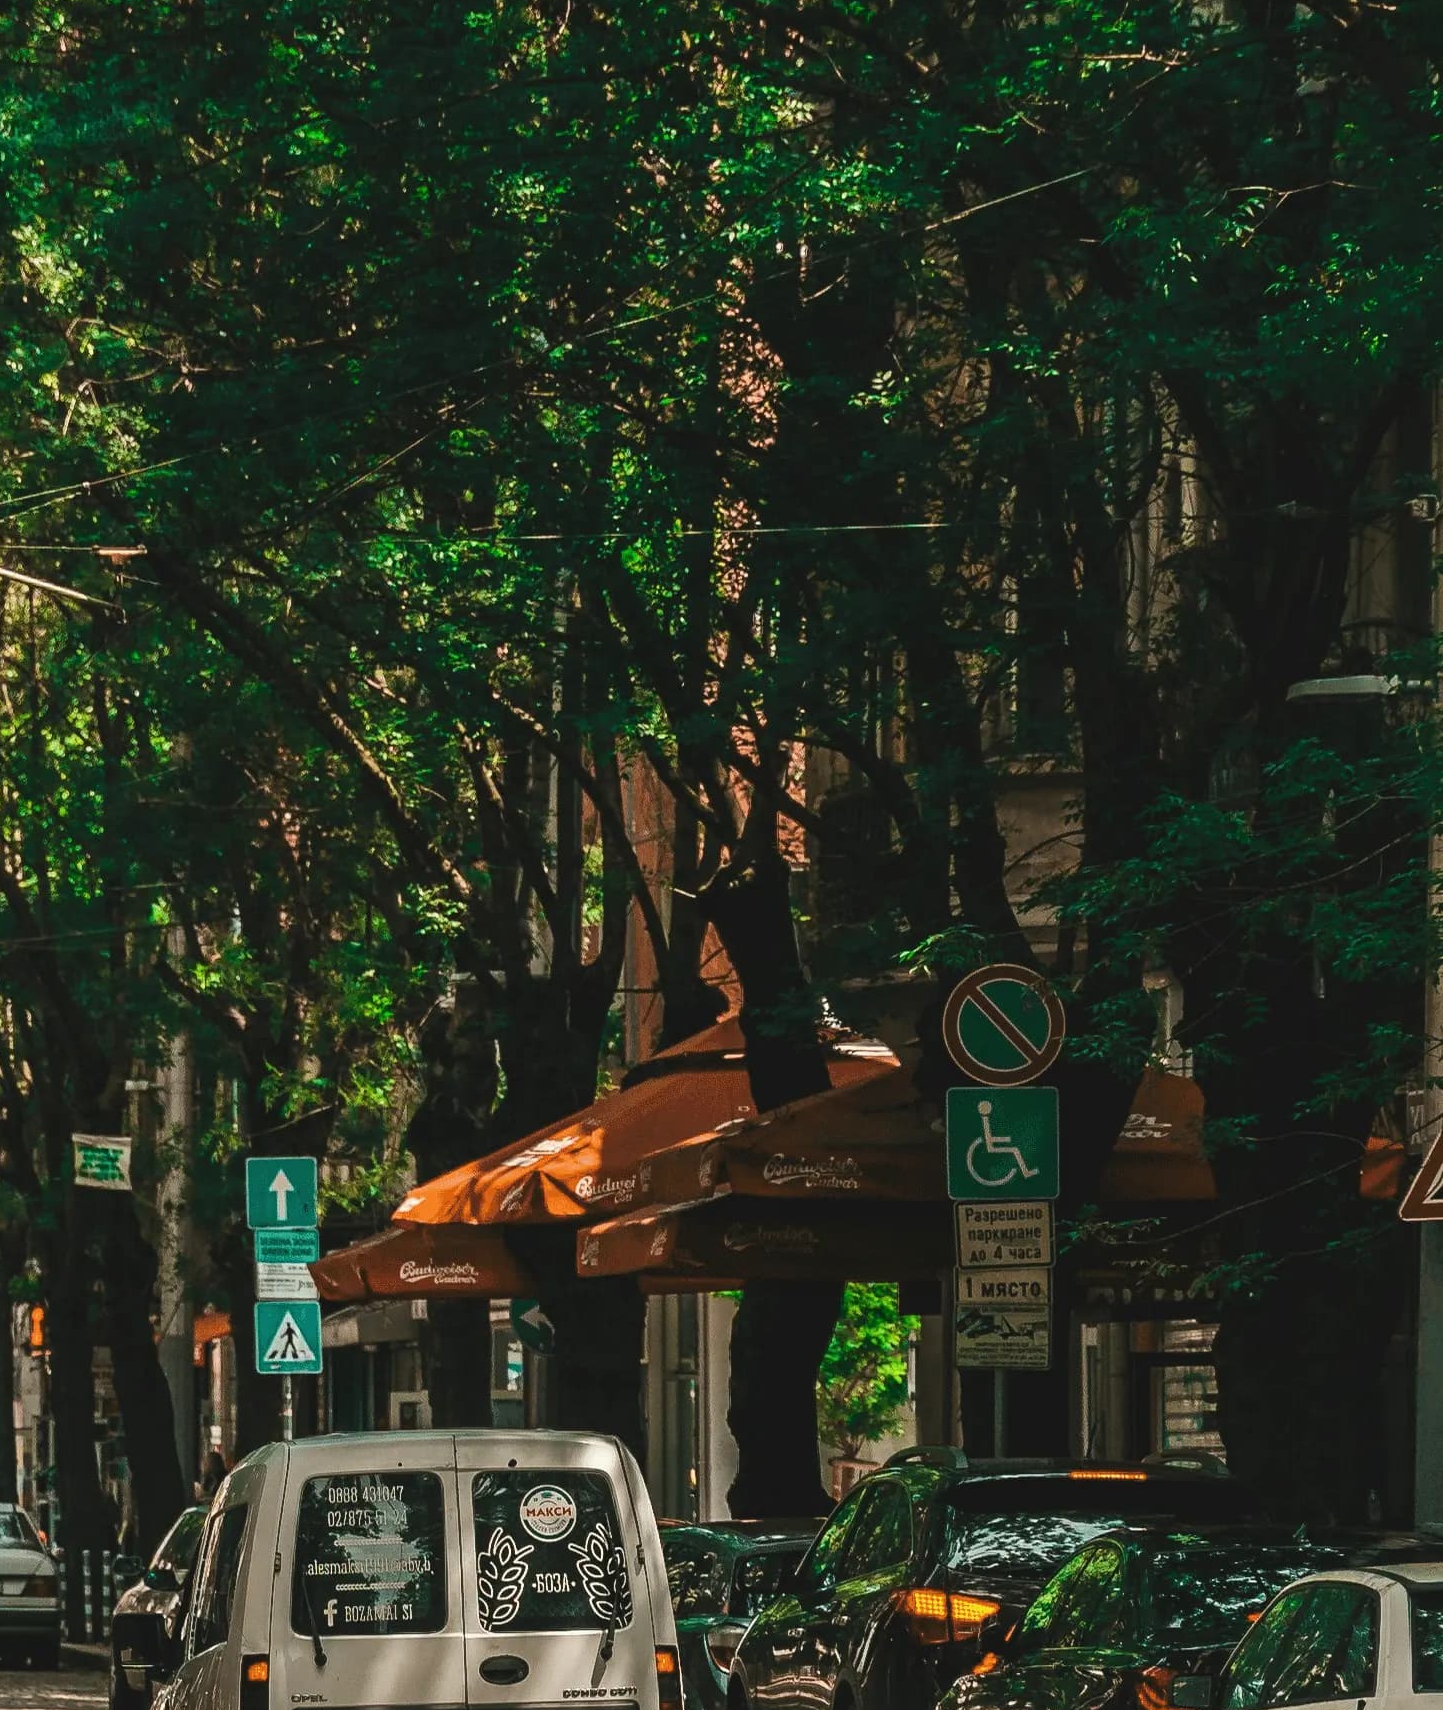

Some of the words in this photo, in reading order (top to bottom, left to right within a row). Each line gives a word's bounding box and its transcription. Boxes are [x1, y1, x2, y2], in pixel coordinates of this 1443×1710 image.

[575, 1175, 637, 1202] Budwei
[965, 1207, 1043, 1225] Разрешено
[968, 1227, 1042, 1244] паркиране
[969, 1249, 987, 1263] до
[993, 1245, 1003, 1260] 4
[1009, 1247, 1042, 1260] часа
[966, 1276, 973, 1299] 1
[328, 1487, 358, 1504] 0888
[362, 1486, 404, 1503] 431047
[327, 1509, 372, 1528] 02/875
[526, 1506, 572, 1517] МАКСИ
[290, 1693, 328, 1703] OPEL
